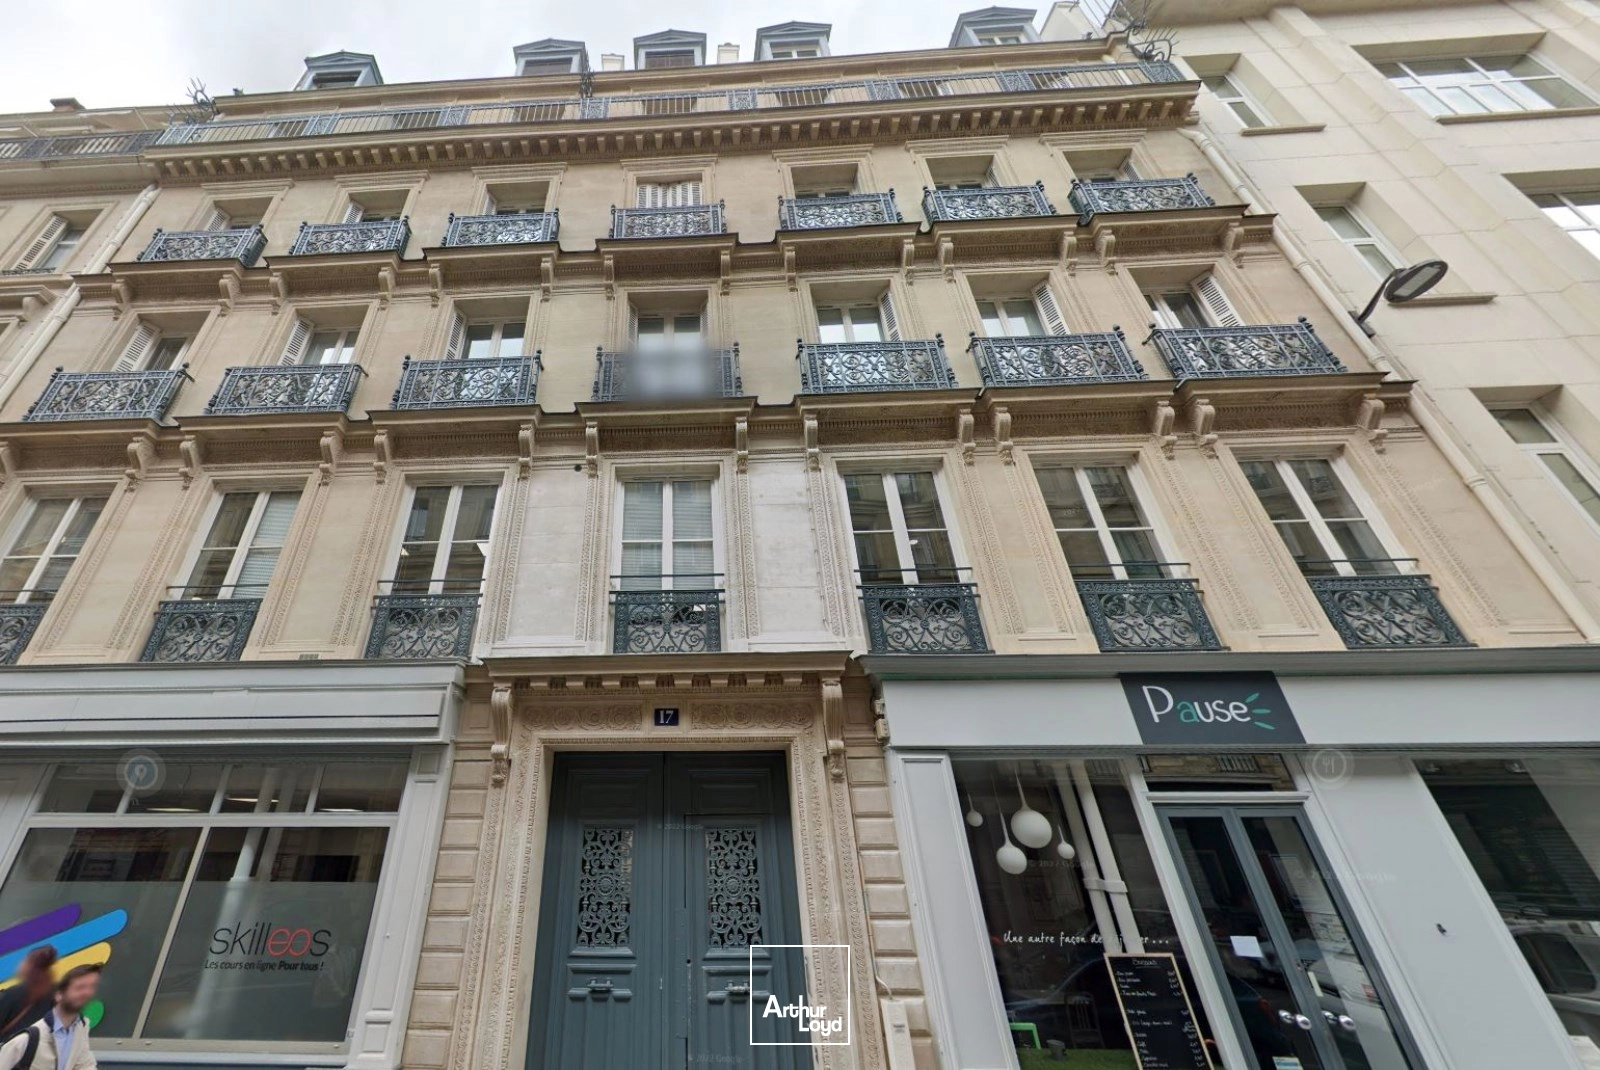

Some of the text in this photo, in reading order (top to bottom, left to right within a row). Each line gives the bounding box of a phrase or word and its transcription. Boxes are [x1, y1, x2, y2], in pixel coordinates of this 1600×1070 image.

[1142, 685, 1251, 723] Pause
[659, 710, 674, 724] 17
[209, 921, 332, 957] skilleos
[1003, 930, 1023, 943] Une
[1027, 932, 1055, 943] autre
[1060, 931, 1087, 946] façon
[204, 960, 218, 969] Les
[220, 962, 243, 970] cours
[244, 962, 255, 970] en
[256, 961, 276, 972] ligne
[278, 961, 300, 971] Pour
